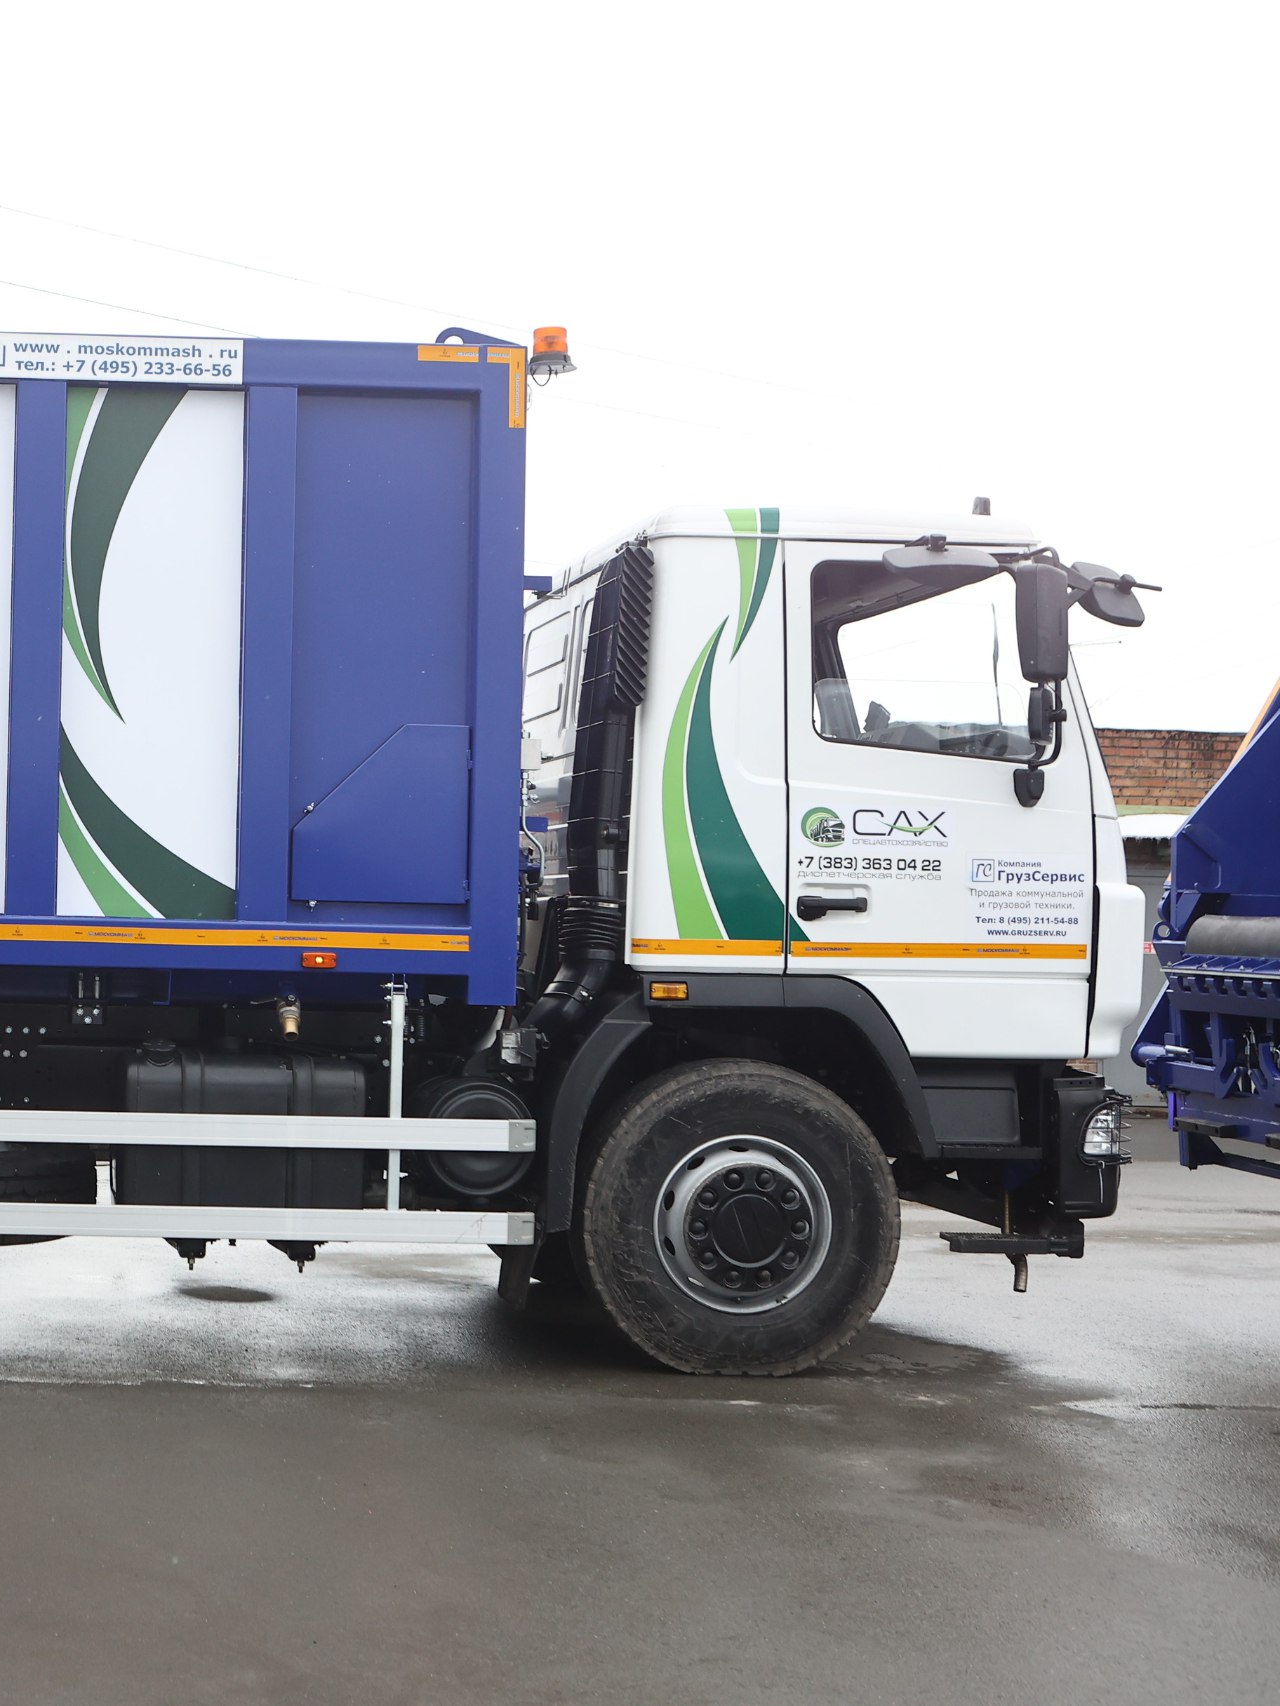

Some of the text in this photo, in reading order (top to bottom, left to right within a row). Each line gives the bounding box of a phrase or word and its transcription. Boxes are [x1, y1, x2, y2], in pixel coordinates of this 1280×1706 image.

[13, 342, 61, 354] www
[78, 343, 202, 358] moskommash
[220, 348, 238, 359] ru
[15, 360, 233, 377] тел.: +7 (495) 233-66-56
[853, 809, 948, 837] САХ
[852, 838, 949, 848] СПЕЦАВТОХОЗЯЙСТВО
[797, 856, 942, 872] +7 (383) 363 04 22
[998, 860, 1042, 868] Компания
[797, 870, 942, 881] диспетчерская служба
[998, 870, 1085, 884] ГрузСервис
[970, 888, 1084, 899] Продажа коммунальной
[988, 901, 1031, 910] грузовой
[1034, 902, 1076, 910] техники.
[976, 916, 997, 924] Тел:
[1007, 916, 1031, 926] (495)
[1034, 917, 1079, 925] 211-54-88
[987, 929, 1067, 937] WWW.GRUZSERV.RU
